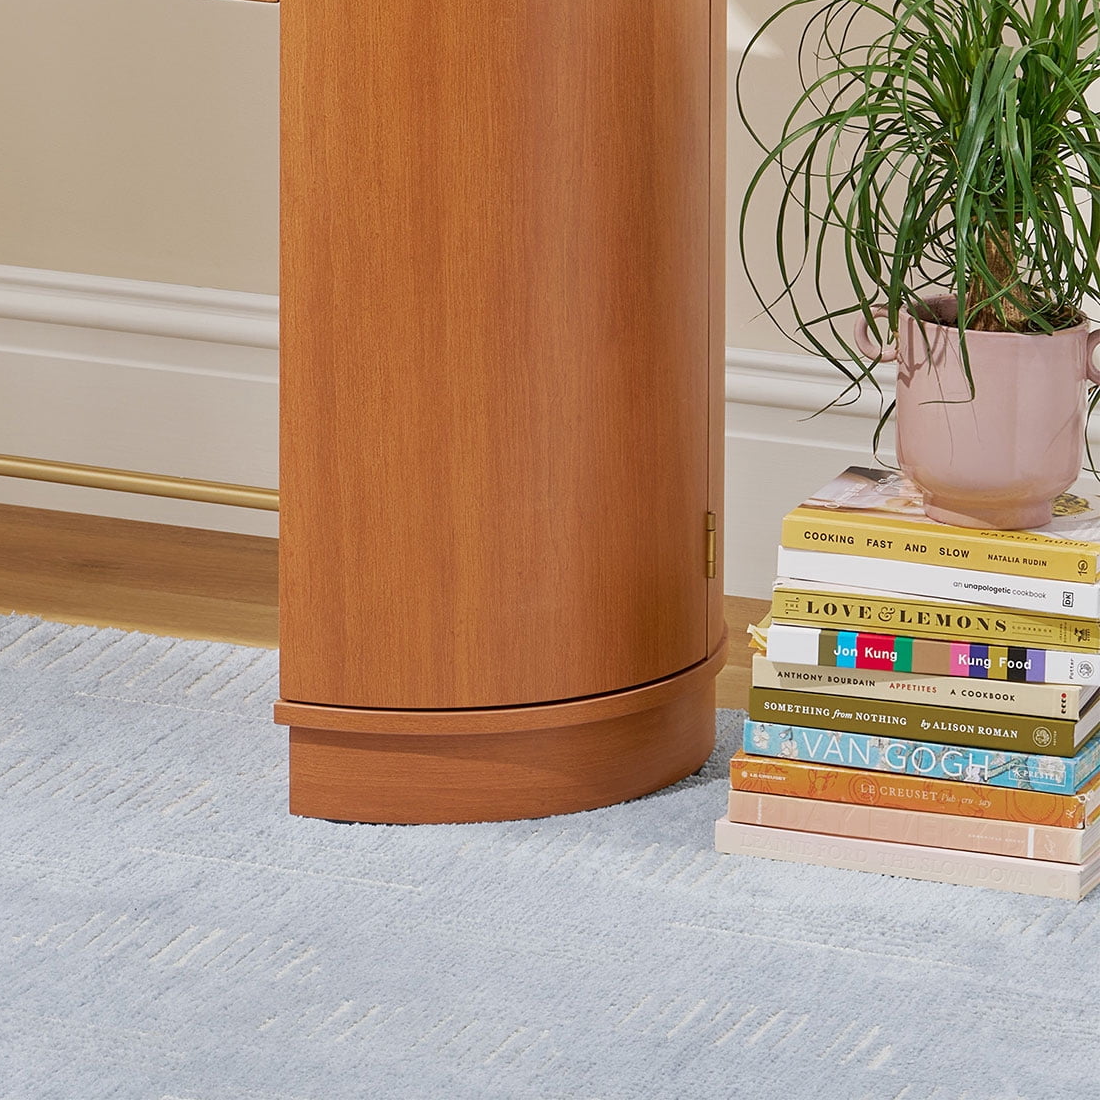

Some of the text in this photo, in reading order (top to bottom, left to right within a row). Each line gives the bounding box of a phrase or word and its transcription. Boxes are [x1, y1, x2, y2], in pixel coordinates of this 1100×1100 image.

[803, 530, 970, 559] COOKING FAST AND SLOW
[980, 531, 1089, 548] NATALIA RUDIN
[987, 553, 1048, 567] NATALIA RUDIN
[953, 580, 1047, 599] an unapologetic cookbook
[1064, 593, 1073, 606] DK
[805, 601, 872, 619] LOVE
[877, 606, 896, 622] &
[899, 609, 1007, 633] LEMONS
[833, 645, 1032, 670] Jon Kung Kung Food
[777, 671, 823, 682] ANTHONY
[827, 675, 876, 687] BOURDAIN
[889, 682, 937, 694] APPETITES
[961, 689, 1016, 702] COOKBOOK
[763, 701, 1018, 739] SOMETHING from NOTHING by ALISON ROMAN
[802, 731, 989, 782] VAN GOGH
[1023, 770, 1060, 782] PRESTEL
[860, 783, 876, 794] LE
[880, 786, 938, 801] CREUSET
